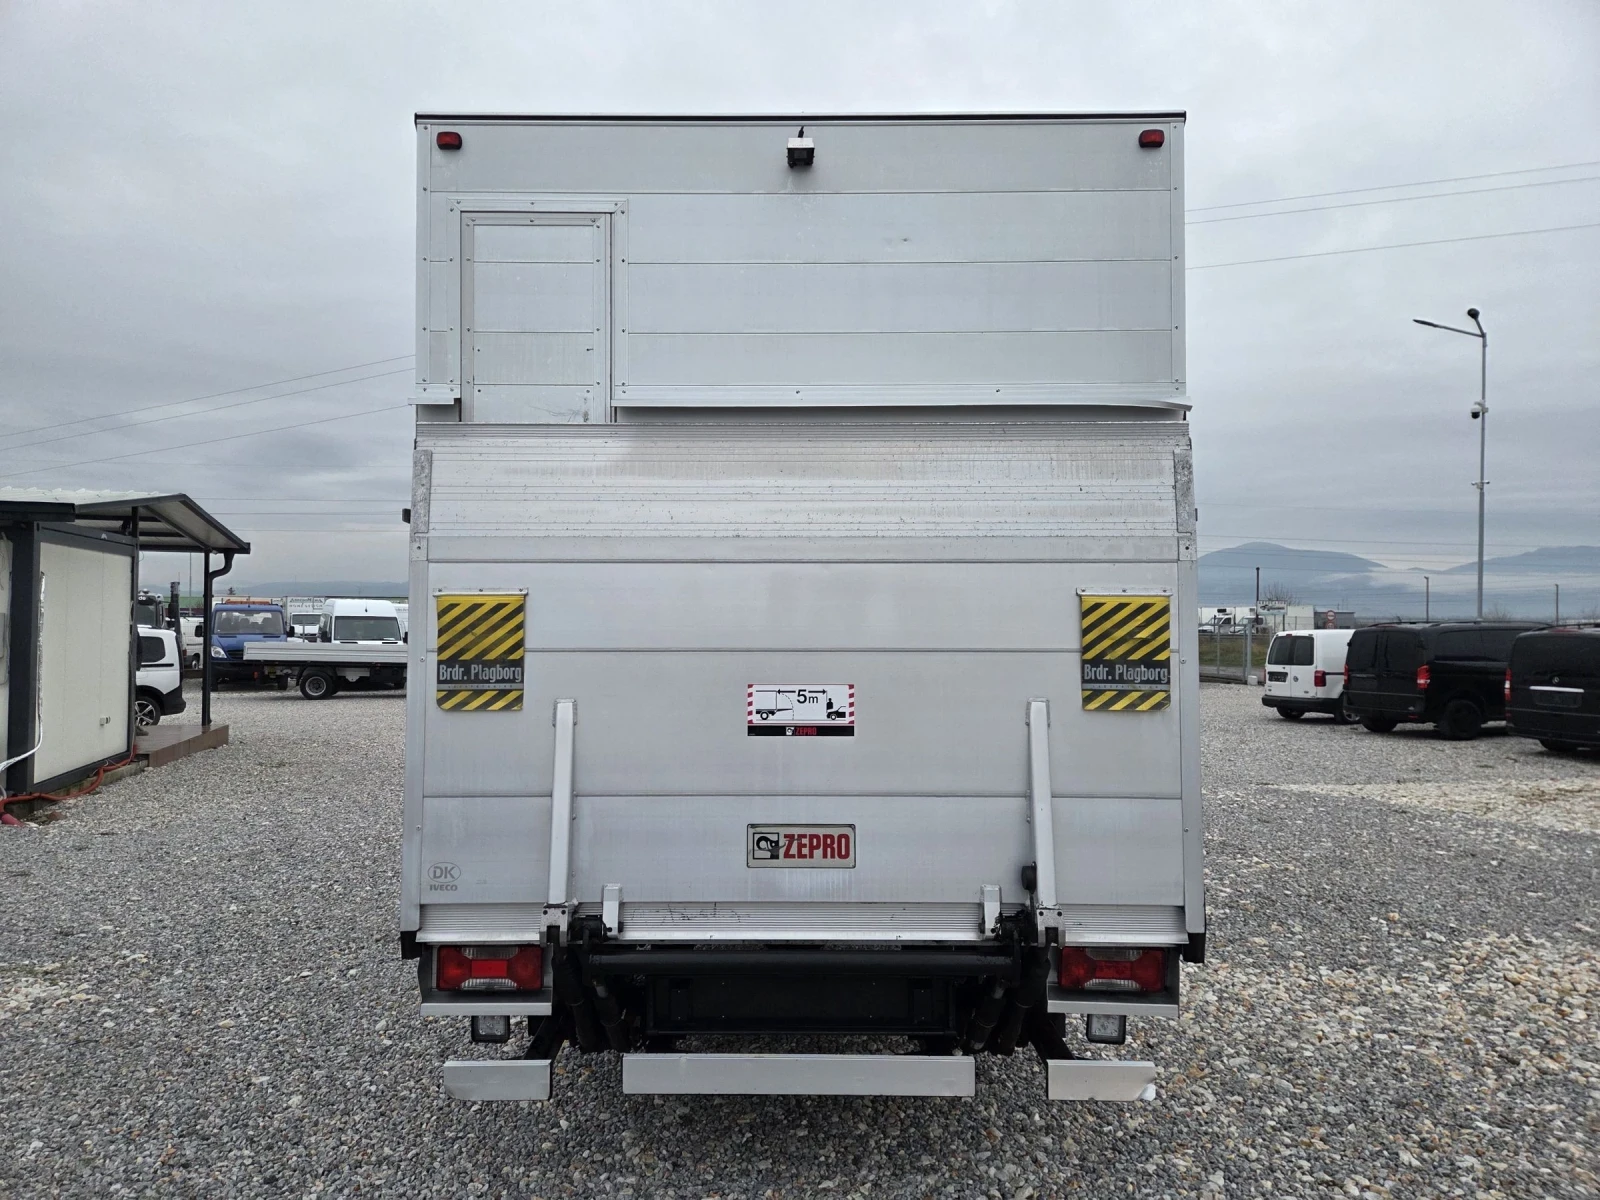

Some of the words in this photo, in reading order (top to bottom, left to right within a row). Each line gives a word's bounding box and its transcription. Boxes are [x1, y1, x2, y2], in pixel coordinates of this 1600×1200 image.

[439, 664, 467, 681] Brdr.
[471, 664, 522, 683] Plagborg
[1084, 664, 1112, 681] Brdr.
[1115, 664, 1168, 683] Plagborg
[795, 727, 817, 735] ZEPRO
[783, 833, 850, 860] ZEPRO
[433, 865, 456, 879] DK
[429, 884, 458, 892] IVECO
